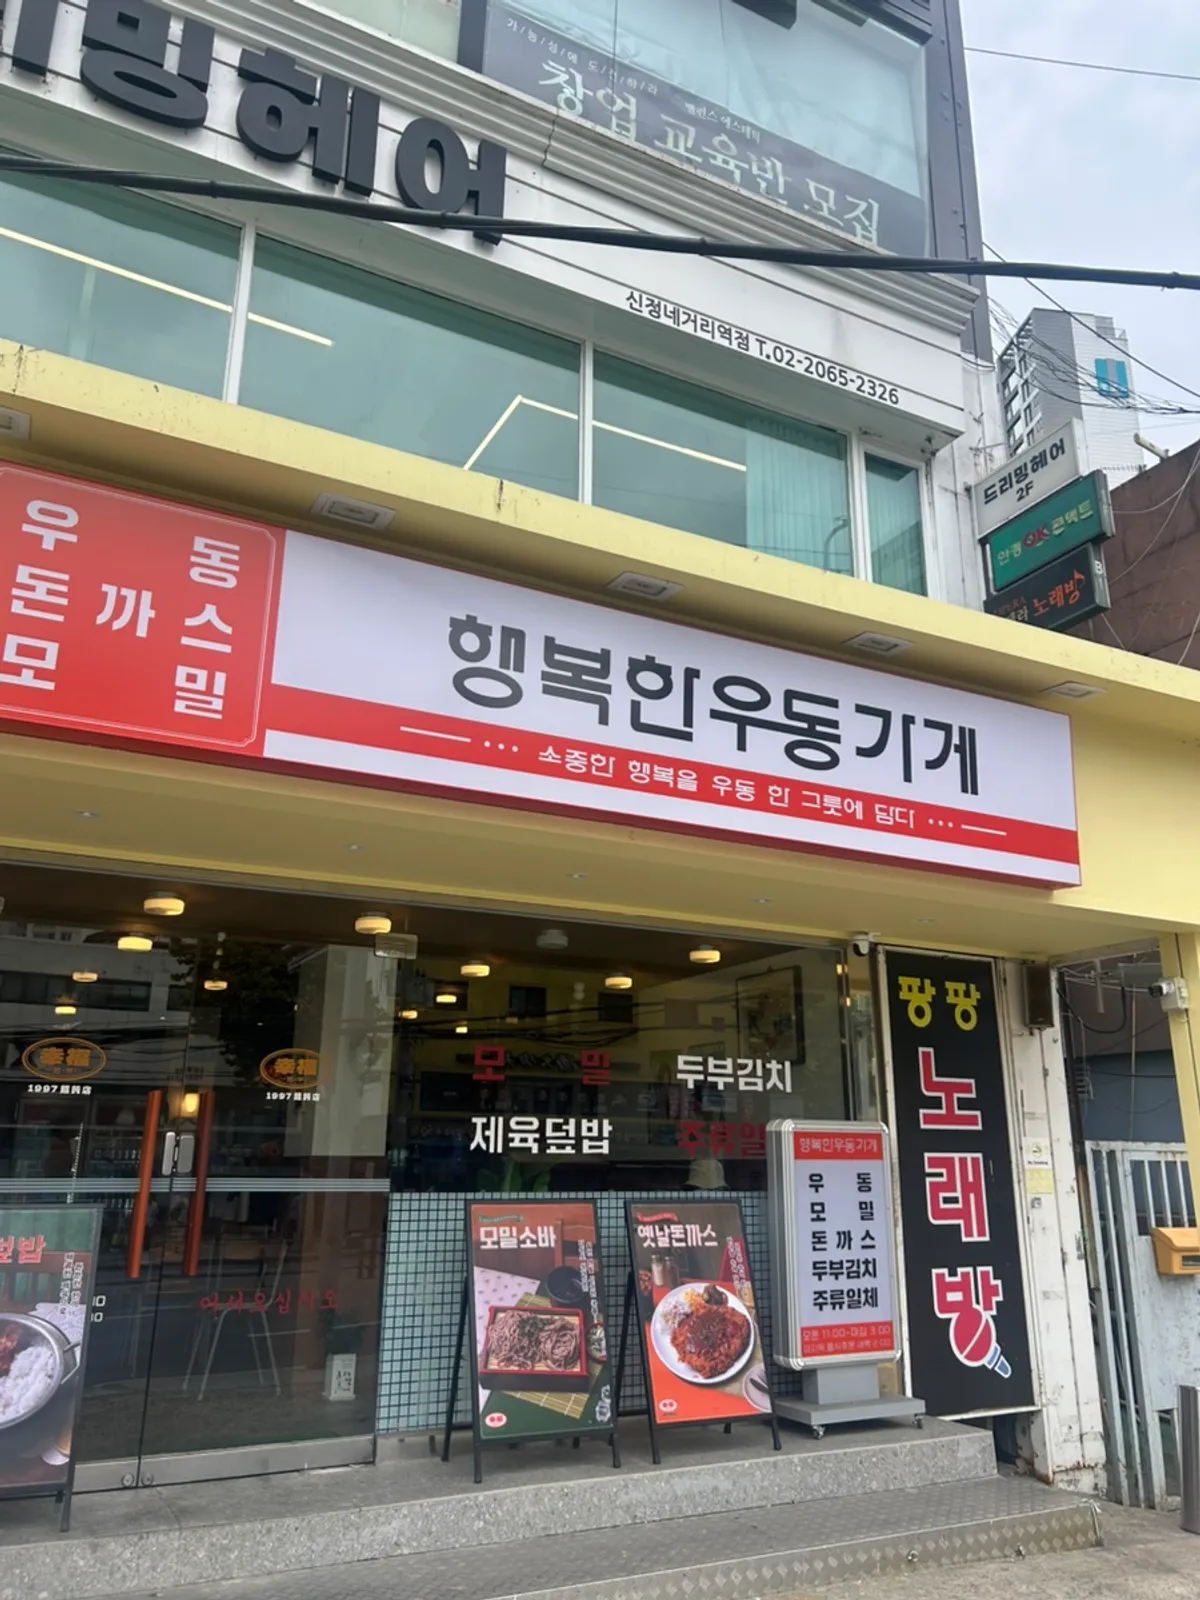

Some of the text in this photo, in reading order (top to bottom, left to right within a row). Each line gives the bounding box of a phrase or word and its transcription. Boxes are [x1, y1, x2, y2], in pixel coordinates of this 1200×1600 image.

[538, 60, 880, 248] 창업 교육반 모집
[625, 290, 900, 406] 신정네거리역점 T.02-2065-2326
[983, 437, 1066, 505] 드리밍헤어
[1016, 480, 1034, 502] 2F
[1023, 524, 1051, 548] OK
[1032, 570, 1086, 616] 노래방
[448, 613, 979, 796] 행복한우동가게
[538, 745, 916, 830] 소중한 행복을 우동 한 그릇에 담다
[27, 1083, 59, 1093] 1997
[676, 1054, 792, 1093] 두부김치
[469, 1115, 613, 1155] 제육덮밥
[799, 1137, 877, 1153] 행복한우동가게
[917, 1046, 1005, 1368] 노래방
[479, 1225, 557, 1249] 모밀소바
[637, 1223, 718, 1248] 옛날돈까스
[811, 1258, 878, 1281] 두부김치
[812, 1286, 879, 1312] 주류일체
